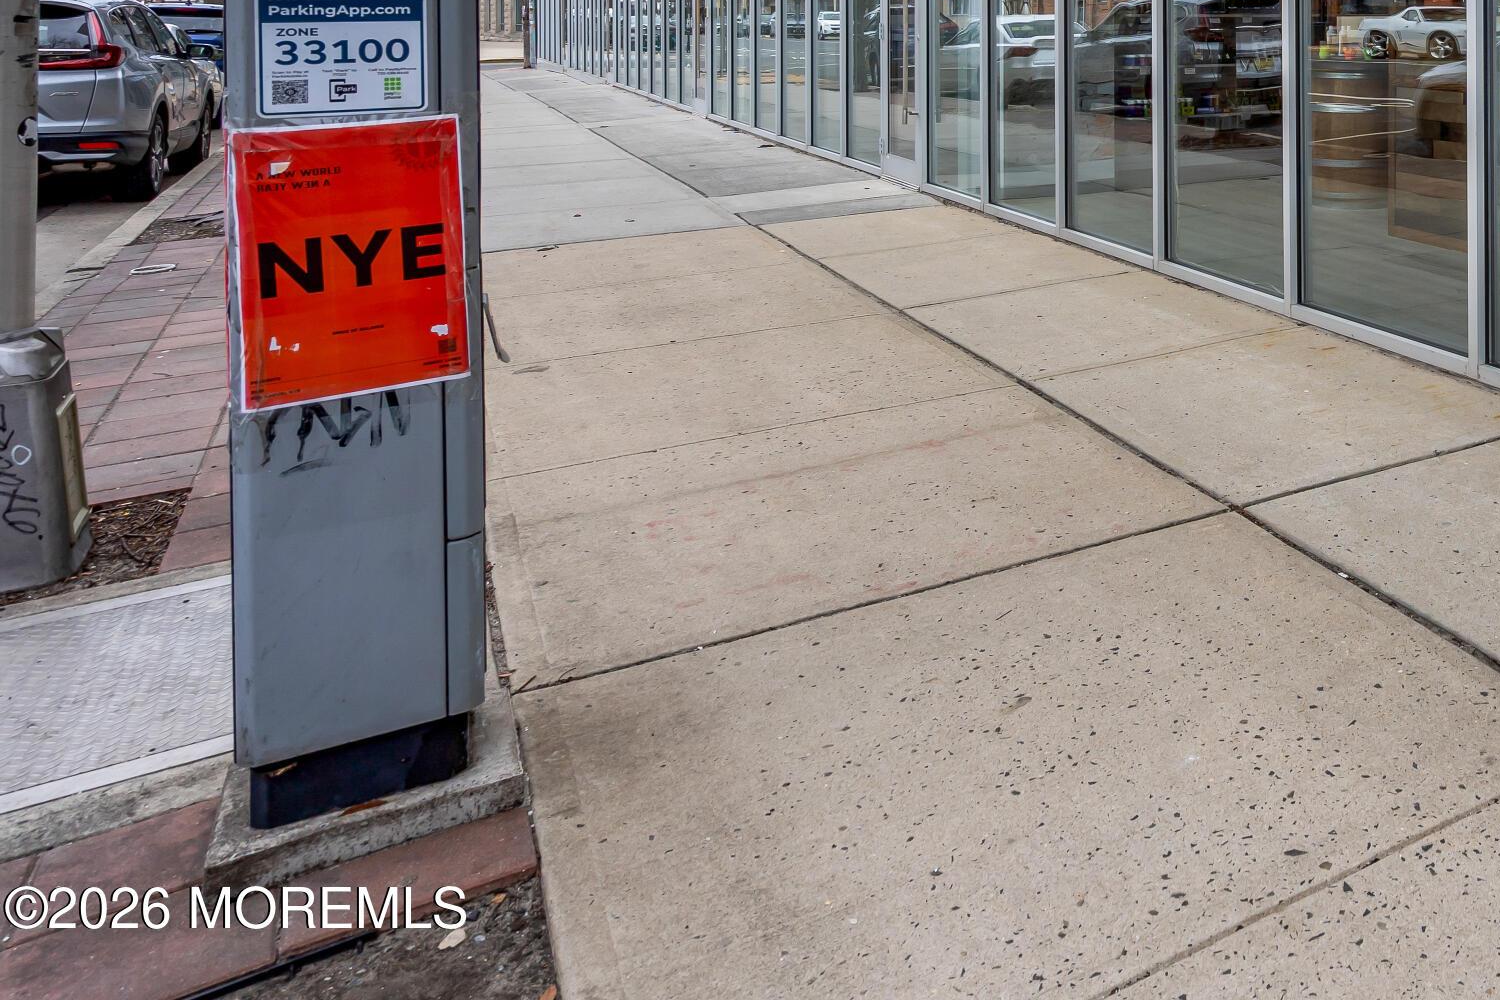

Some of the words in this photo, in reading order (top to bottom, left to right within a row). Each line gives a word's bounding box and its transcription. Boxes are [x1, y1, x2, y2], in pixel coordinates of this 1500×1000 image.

[268, 4, 411, 18] ParkingApp.com
[276, 28, 318, 36] ZONE
[274, 38, 410, 66] 33100
[300, 166, 342, 176] WORLD
[257, 222, 446, 300] NYE
